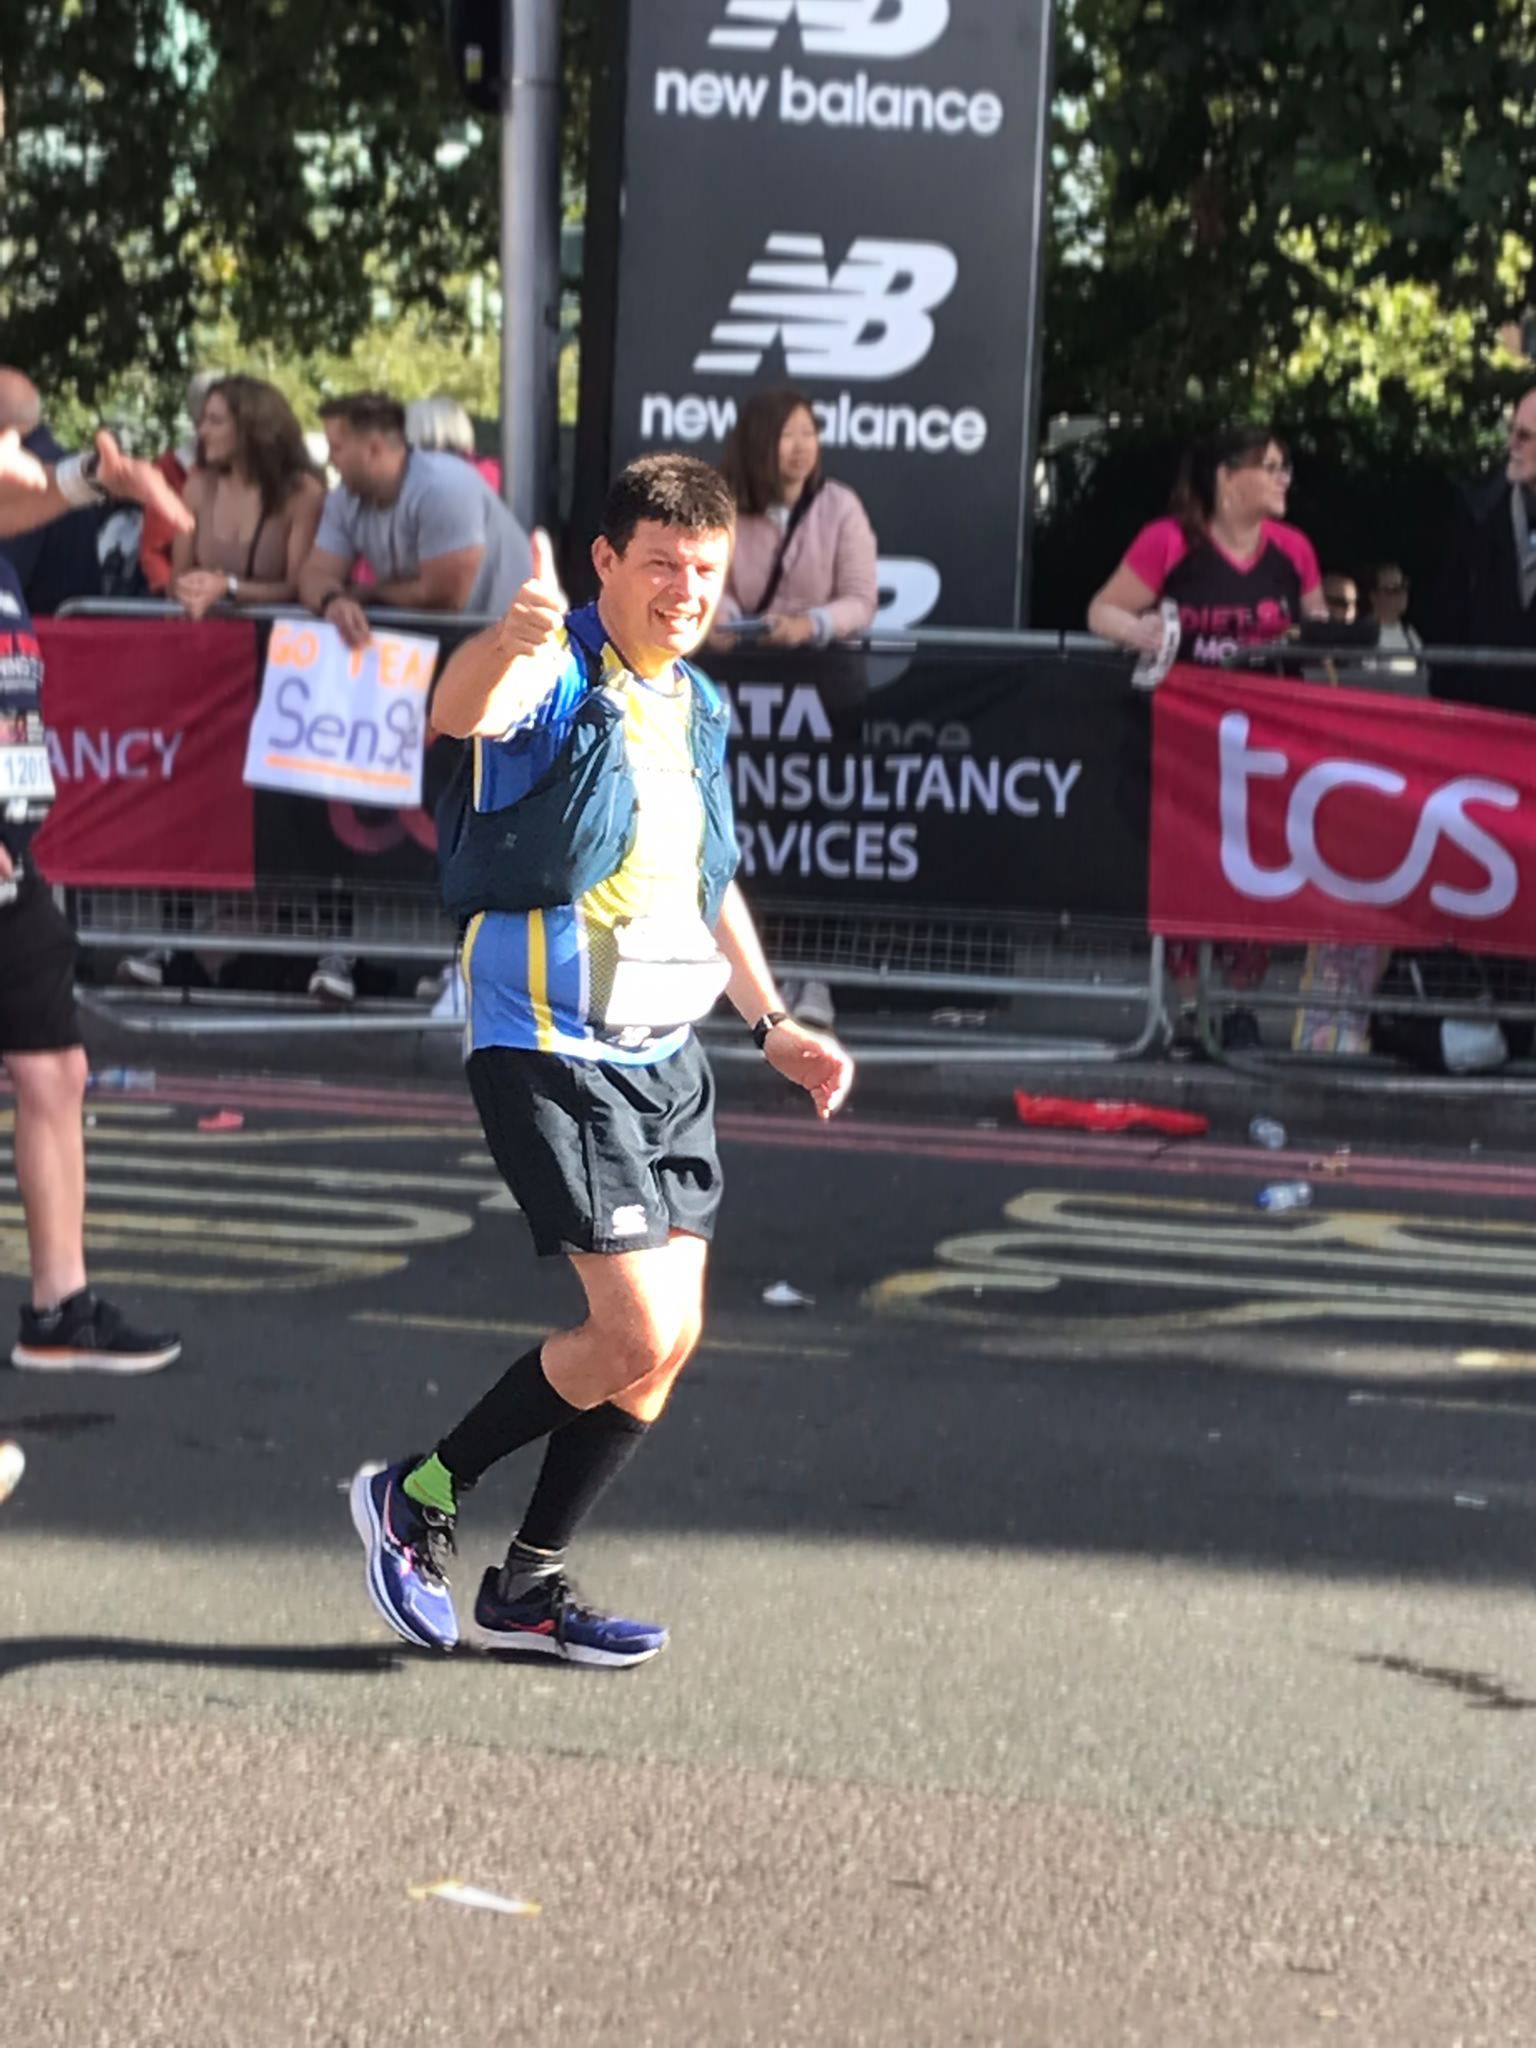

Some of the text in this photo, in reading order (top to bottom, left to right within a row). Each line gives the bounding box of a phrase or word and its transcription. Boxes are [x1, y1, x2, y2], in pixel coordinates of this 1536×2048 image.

[654, 66, 1003, 136] new balance
[693, 231, 959, 381] NB
[810, 390, 988, 455] alance
[268, 624, 319, 669] GO
[44, 726, 184, 784] ANCY
[736, 750, 1083, 818] NSULTANCY
[1218, 709, 1519, 921] tcs
[735, 819, 920, 882] RVICES
